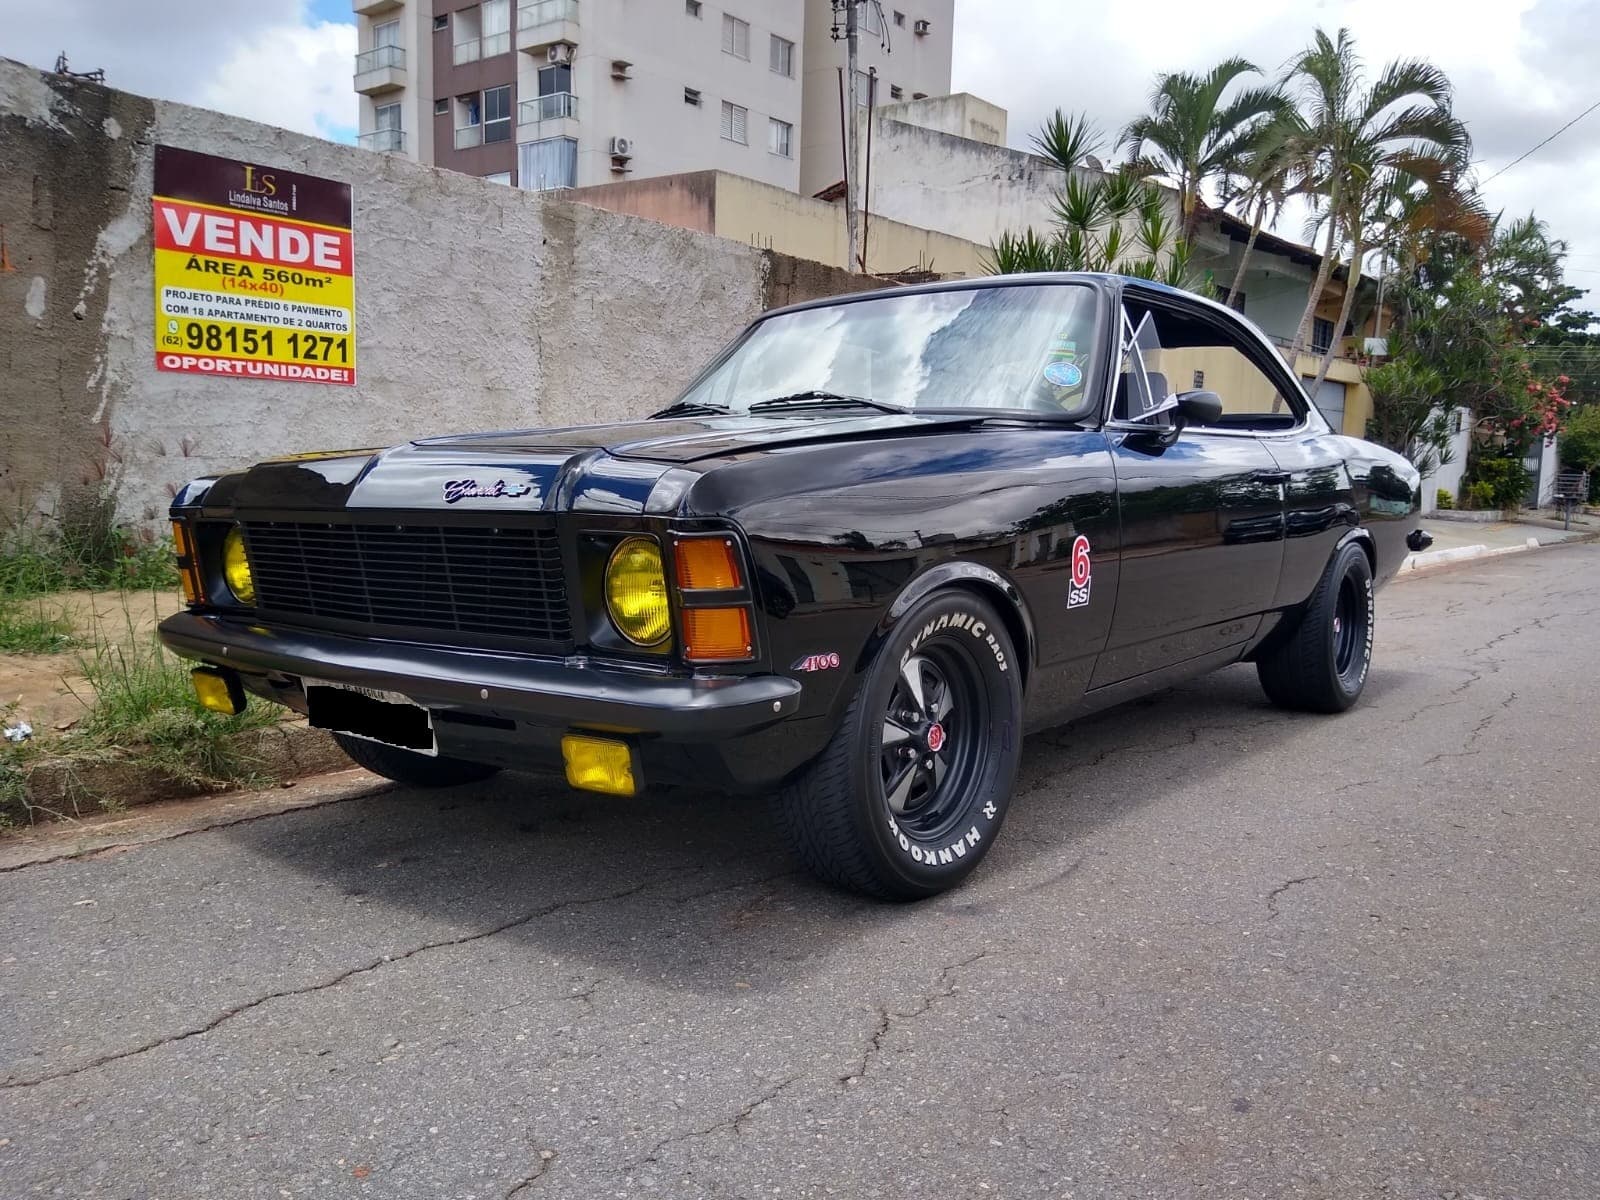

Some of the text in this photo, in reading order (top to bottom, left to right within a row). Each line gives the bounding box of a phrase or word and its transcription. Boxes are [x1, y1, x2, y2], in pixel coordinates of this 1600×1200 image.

[243, 165, 276, 196] LS
[229, 190, 261, 206] Lindalva
[263, 196, 288, 211] Santos
[162, 208, 341, 269] VENDE
[185, 255, 254, 278] ÁREA
[222, 277, 285, 297] (14x40)
[165, 289, 213, 303] PROJETO
[216, 295, 242, 306] PARA
[283, 304, 289, 312] 6
[291, 305, 343, 318] PAVIMENTO
[166, 304, 348, 332] COM 18 APARTAMENTO DE 2 QUARTOS
[162, 322, 347, 363] (62) 98151 1271
[163, 355, 349, 381] OPORTUNIDADE!
[1072, 535, 1091, 588] 6
[1069, 588, 1088, 604] SS
[888, 813, 981, 866] HANKOOK
